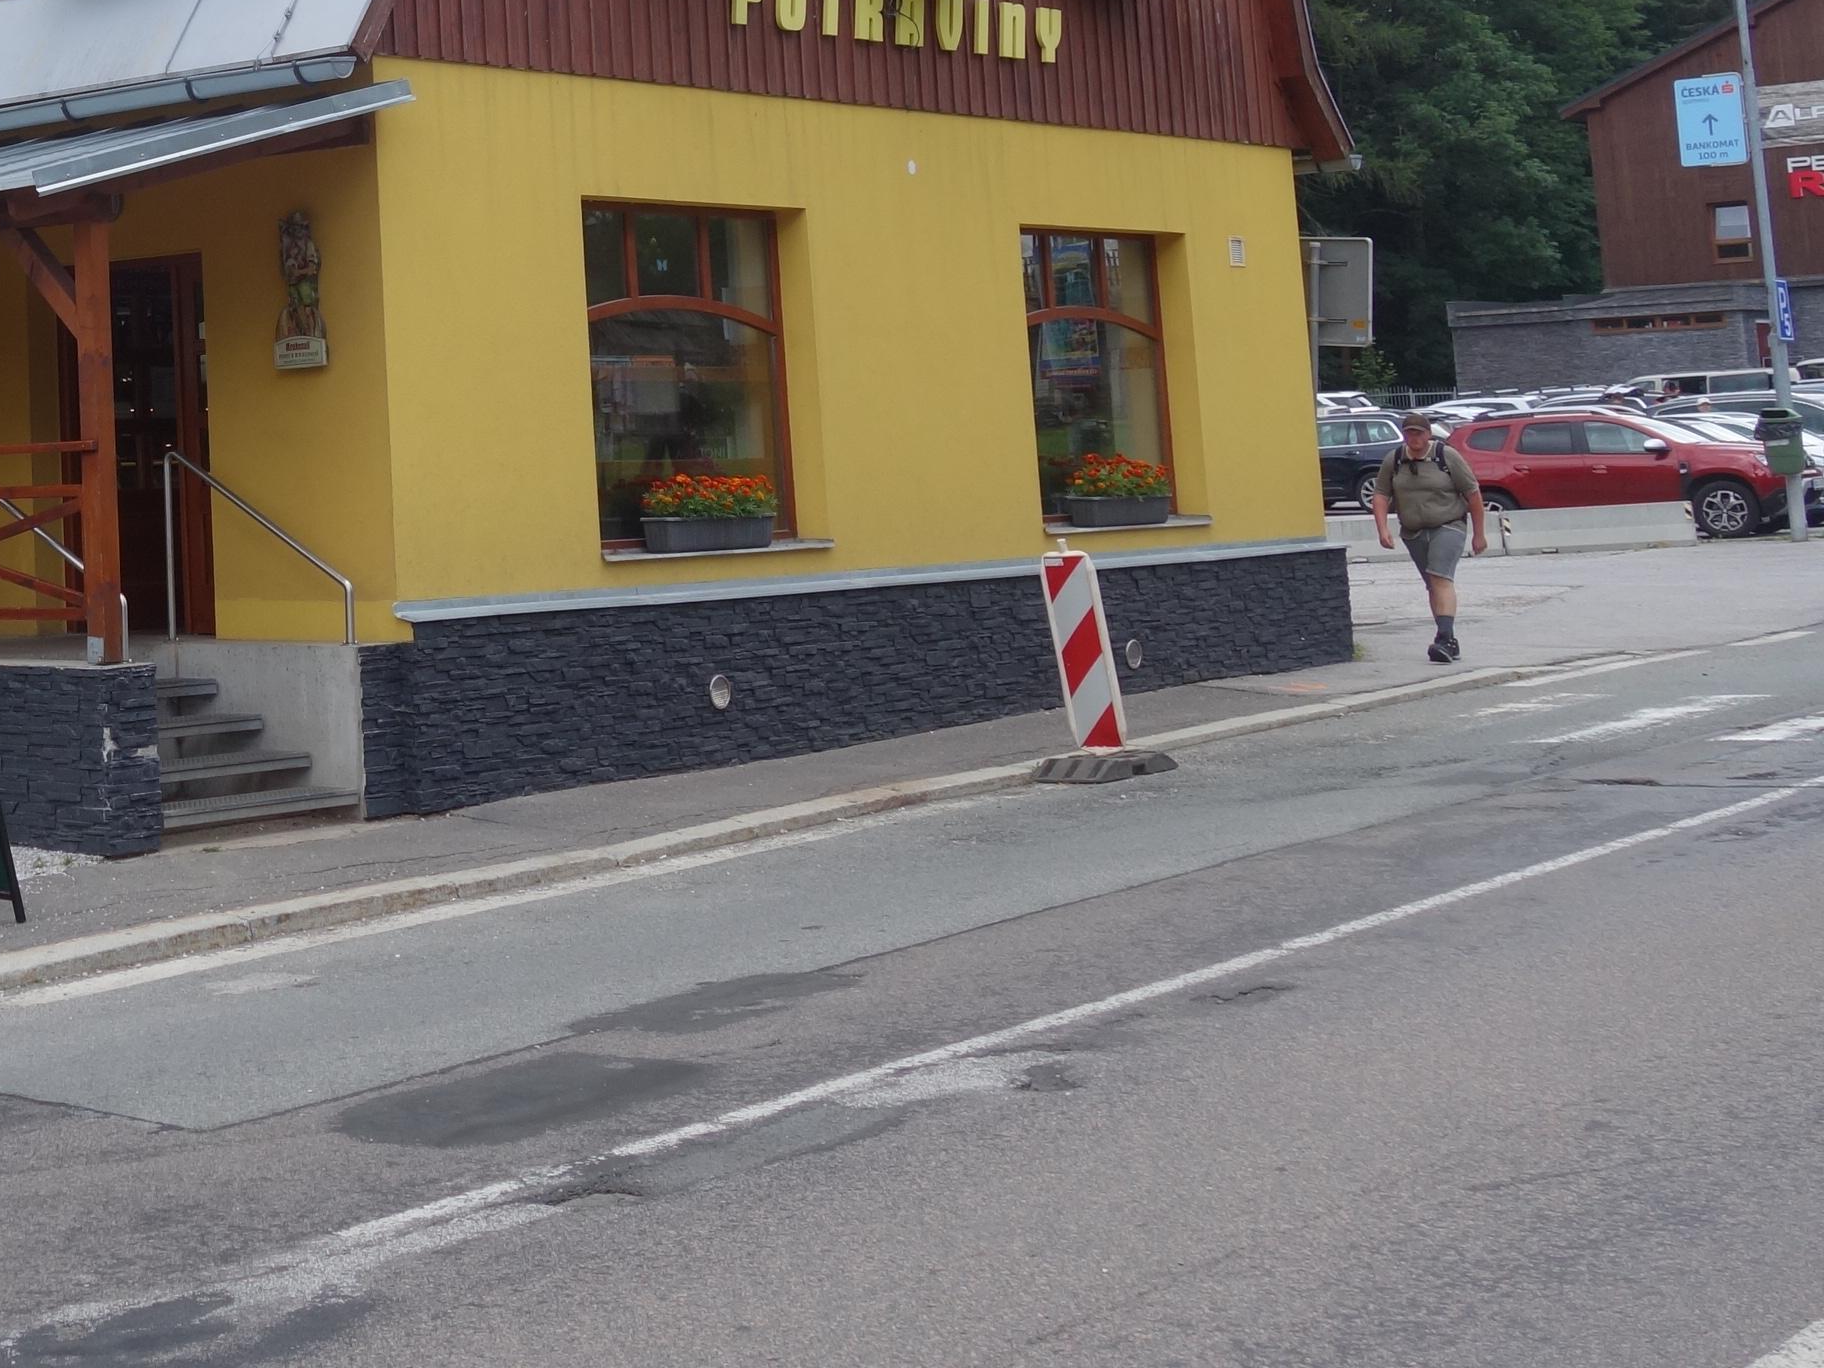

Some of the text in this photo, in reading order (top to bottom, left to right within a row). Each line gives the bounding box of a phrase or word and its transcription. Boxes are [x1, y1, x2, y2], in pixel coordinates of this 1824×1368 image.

[1681, 83, 1720, 98] ČESKÁ
[1685, 139, 1739, 151] BANKOMAT
[1698, 151, 1717, 160] 100
